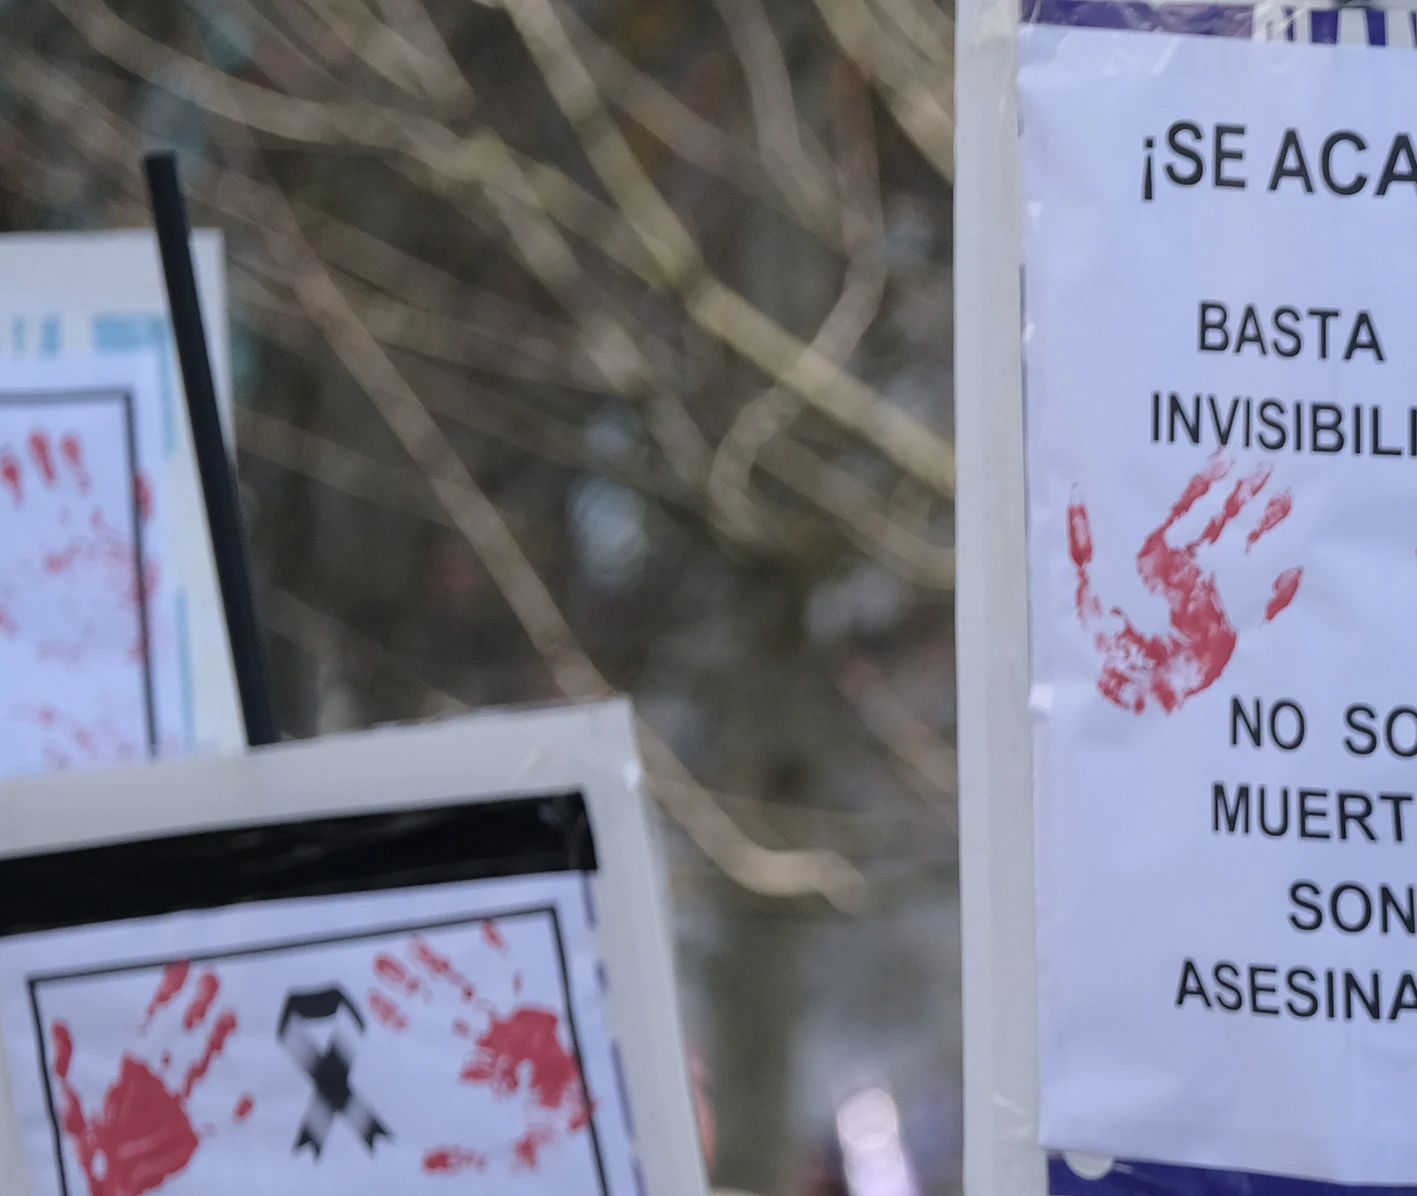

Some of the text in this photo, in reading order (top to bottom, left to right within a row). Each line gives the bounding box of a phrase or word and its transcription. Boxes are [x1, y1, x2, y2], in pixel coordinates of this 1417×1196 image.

[1143, 121, 1246, 202] ¡SE
[1198, 302, 1385, 362] BASTA
[1231, 696, 1306, 751] NO
[1289, 881, 1417, 935] SON
